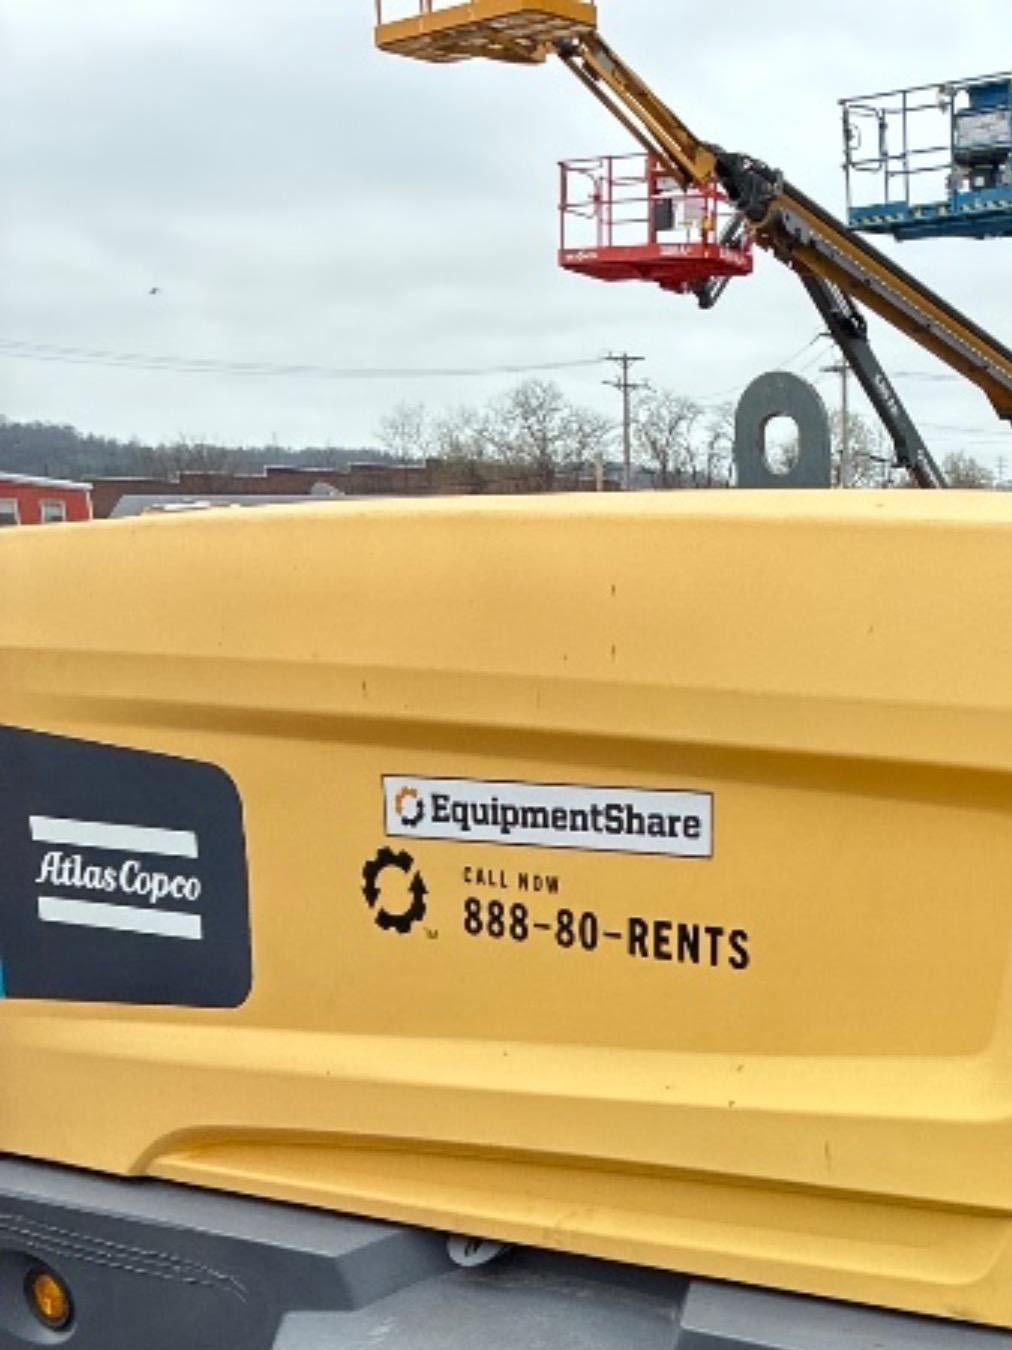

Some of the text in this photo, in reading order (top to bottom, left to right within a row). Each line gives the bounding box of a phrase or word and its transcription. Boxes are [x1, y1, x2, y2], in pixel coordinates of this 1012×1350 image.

[430, 793, 703, 840] EquipmentShare
[35, 851, 202, 904] Atlas Copco
[463, 866, 560, 894] CALL NOW
[463, 896, 751, 970] 888-80-RENTS
